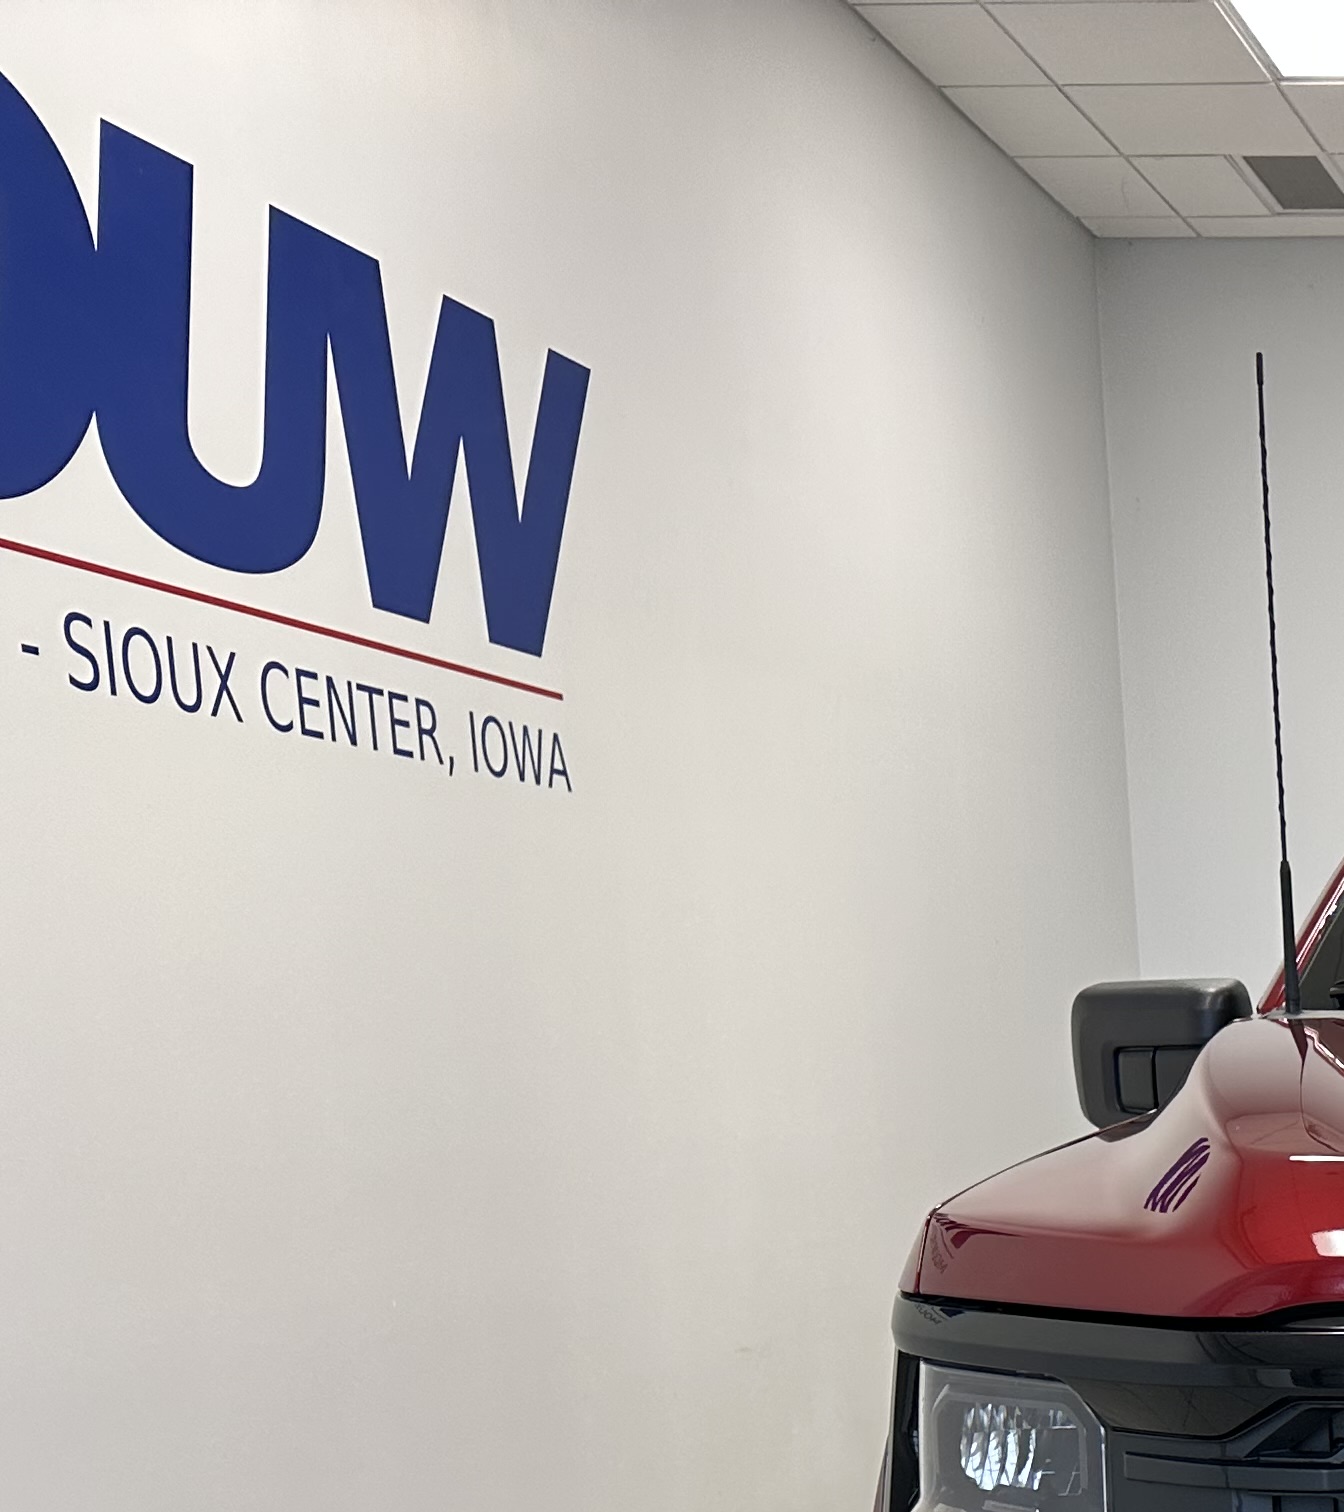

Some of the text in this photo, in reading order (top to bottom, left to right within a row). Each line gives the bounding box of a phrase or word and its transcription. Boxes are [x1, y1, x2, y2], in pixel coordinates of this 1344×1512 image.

[63, 611, 244, 723] SIOUX
[260, 660, 457, 777] CENTER,
[469, 710, 573, 793] IOWA
